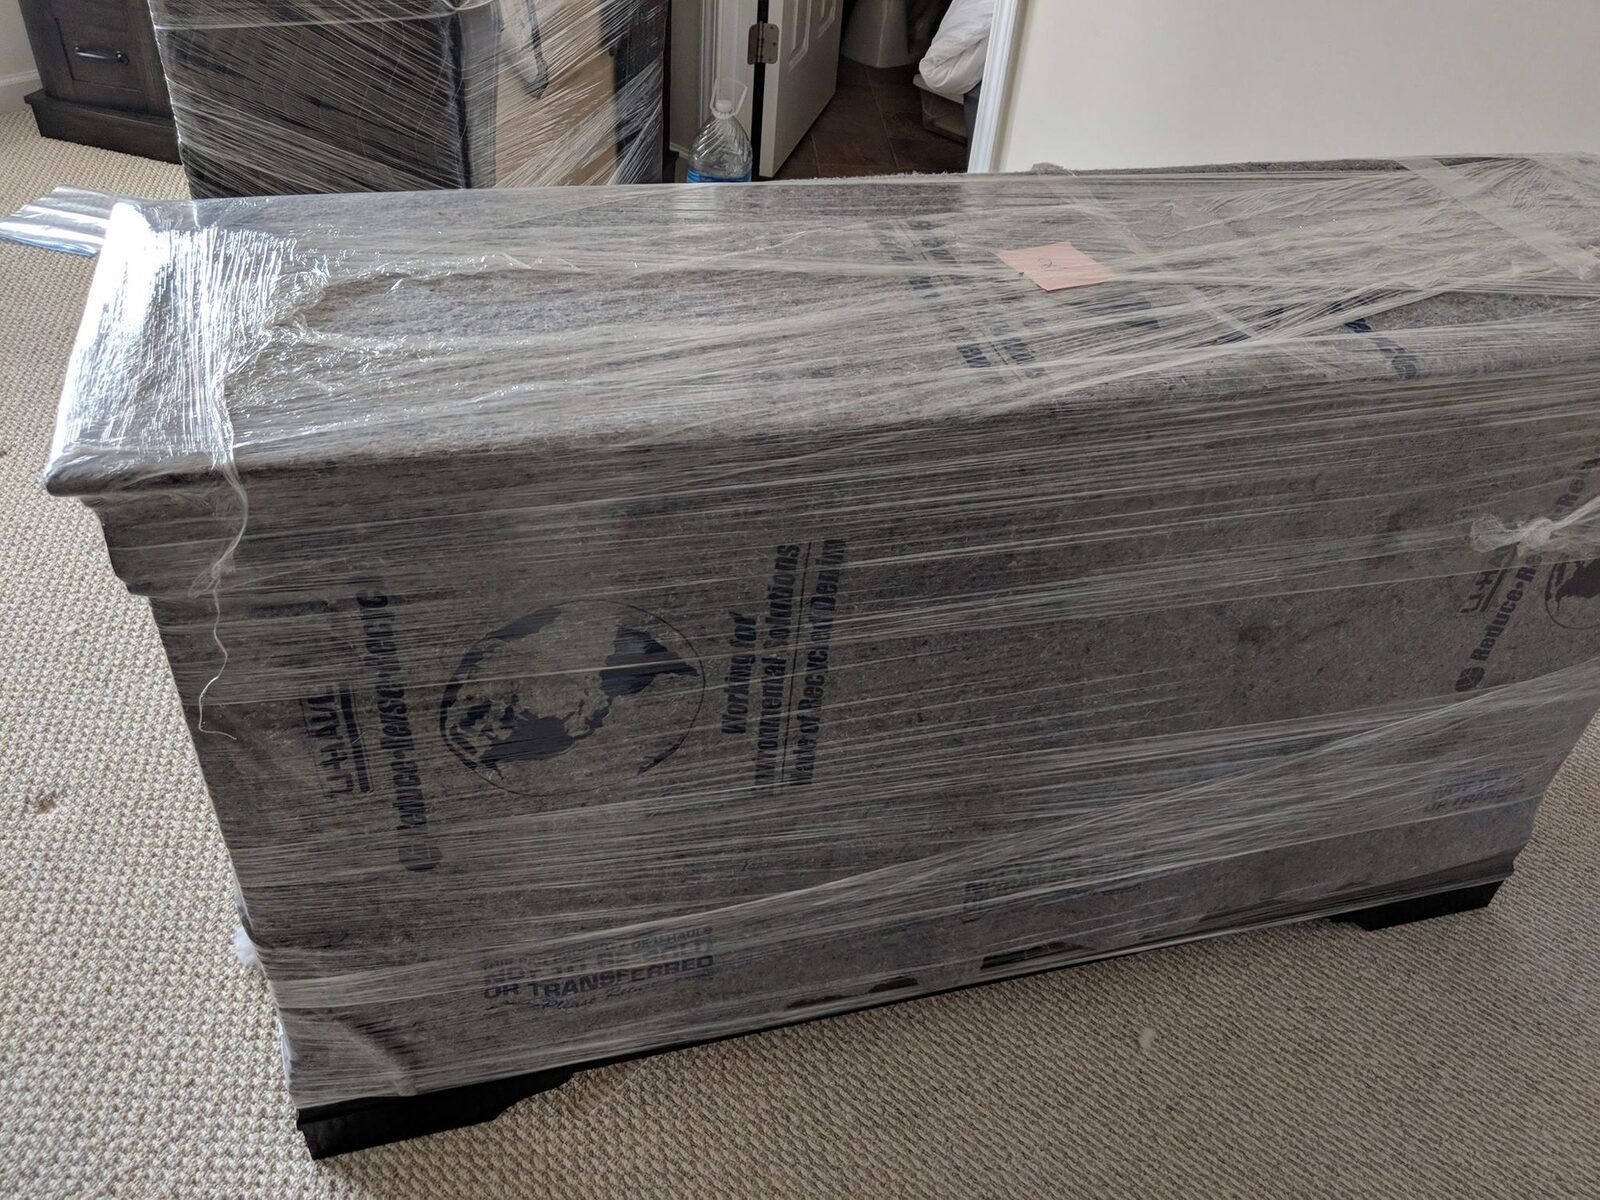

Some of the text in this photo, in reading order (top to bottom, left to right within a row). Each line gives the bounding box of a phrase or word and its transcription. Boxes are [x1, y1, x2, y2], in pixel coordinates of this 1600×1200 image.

[721, 609, 758, 735] Working for
[753, 656, 788, 795] nvironmental
[797, 713, 821, 735] of
[484, 983, 520, 999] OR
[528, 954, 714, 997] TRANSFERRED
